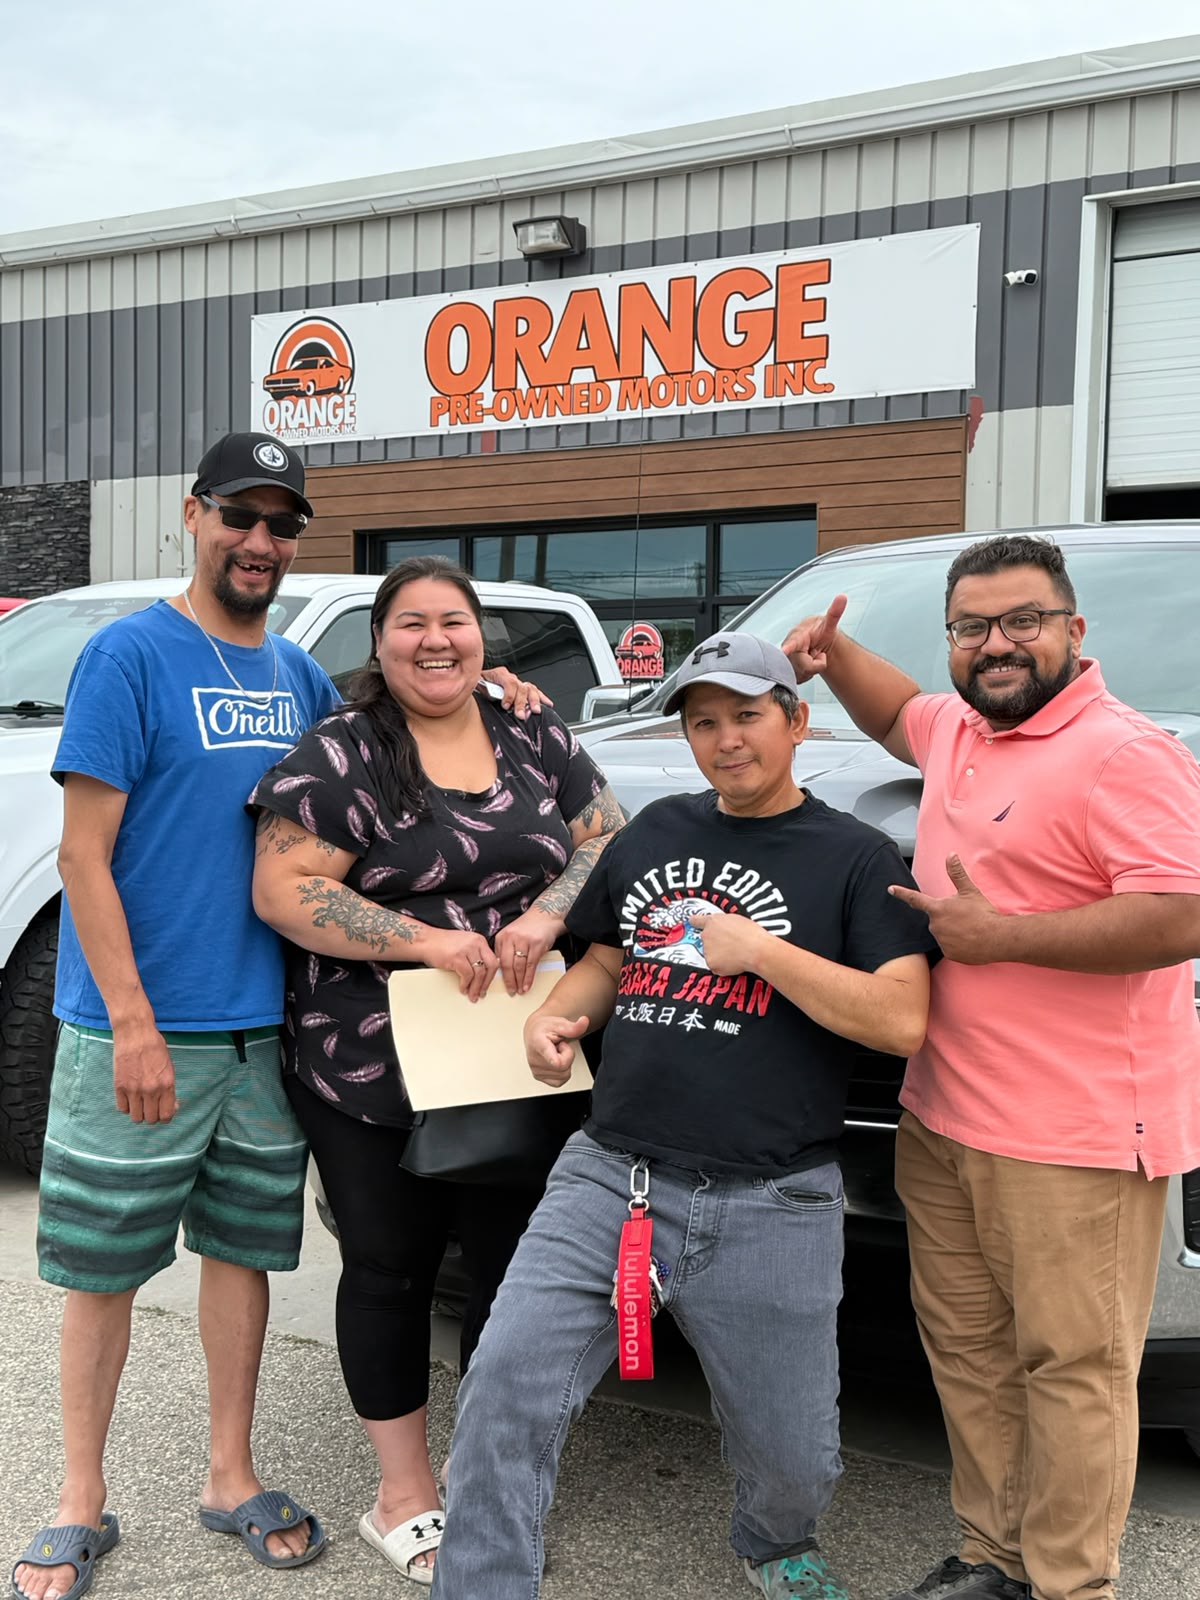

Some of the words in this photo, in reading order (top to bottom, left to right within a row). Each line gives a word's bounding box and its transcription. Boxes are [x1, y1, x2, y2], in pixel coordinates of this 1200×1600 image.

[425, 258, 830, 397] ORANGE
[263, 393, 357, 431] ORANGE
[429, 381, 612, 427] PRE-OWNED
[616, 366, 756, 411] MOTORS
[763, 359, 835, 398] INC.
[616, 657, 663, 674] ORANGE
[619, 857, 705, 948] LIMITED
[712, 861, 792, 936] EDITIO
[672, 972, 774, 1018] JAPAN
[713, 1019, 742, 1036] MADE
[623, 1251, 644, 1371] lululemon
